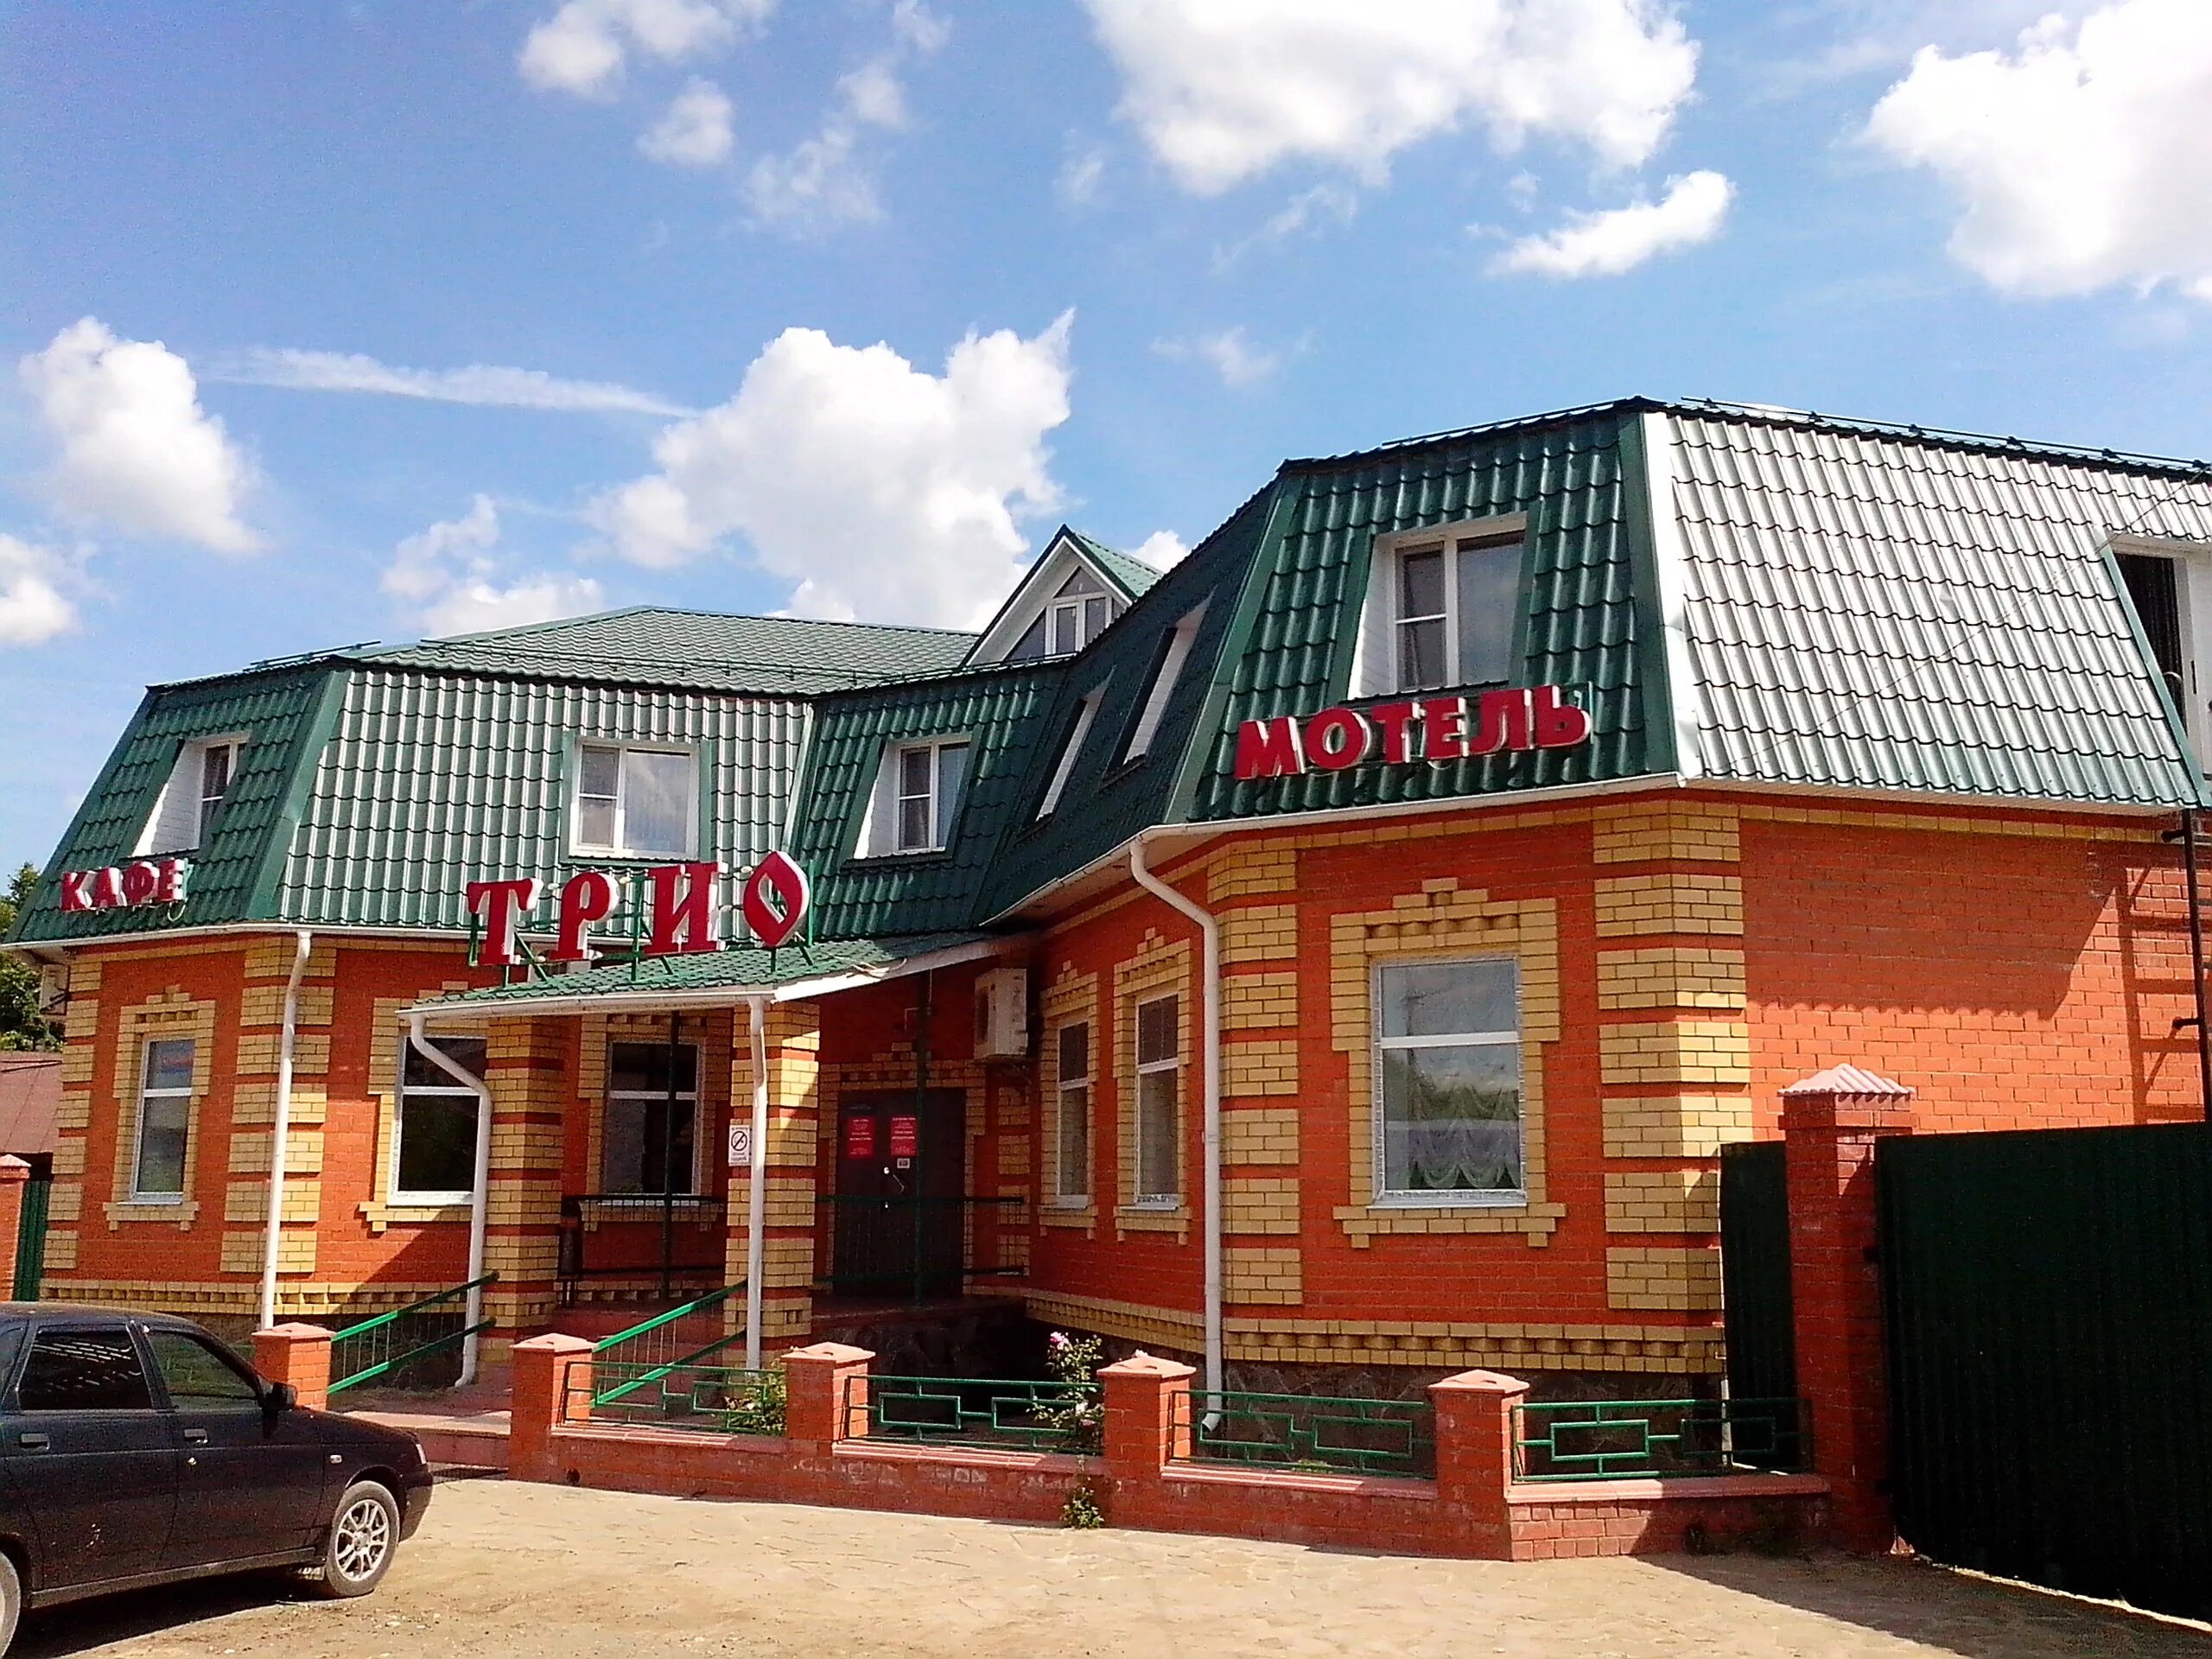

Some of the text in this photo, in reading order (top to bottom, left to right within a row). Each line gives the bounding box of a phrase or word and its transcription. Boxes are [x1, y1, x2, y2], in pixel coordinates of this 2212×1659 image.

[1236, 686, 1591, 779] МОТЕЛЬ
[61, 858, 184, 912] КАФЕ
[466, 851, 809, 966] ТРИО
